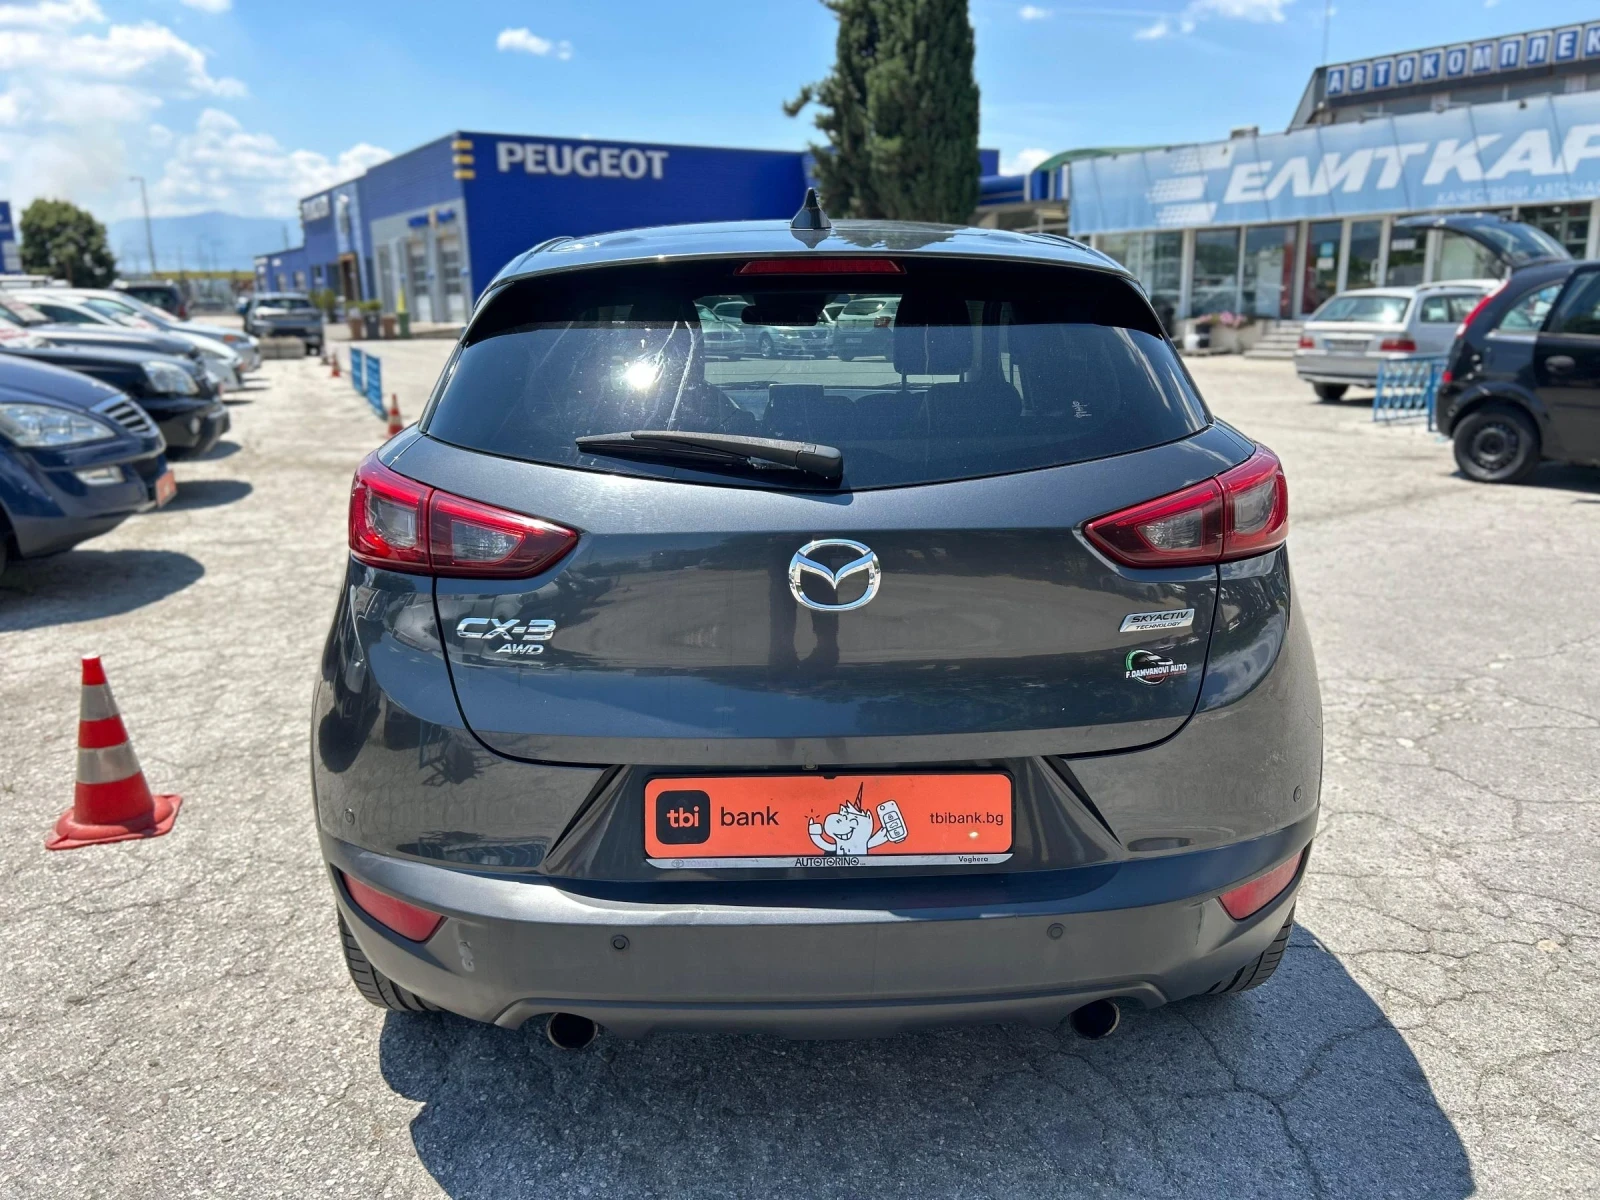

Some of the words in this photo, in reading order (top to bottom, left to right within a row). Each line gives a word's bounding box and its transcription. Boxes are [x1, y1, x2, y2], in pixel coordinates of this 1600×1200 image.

[496, 141, 669, 180] PEUGEOT
[1131, 611, 1188, 623] SKYACTIV
[456, 617, 556, 641] CX-3
[1136, 621, 1181, 630] TECHNOLOGY
[495, 643, 544, 655] AWD
[1170, 663, 1188, 672] AUTO
[667, 805, 699, 828] tbi
[720, 806, 779, 827] bank
[930, 811, 1004, 826] tbibank.bg
[795, 856, 859, 867] AUTOTORINO
[958, 855, 989, 863] Voghera
